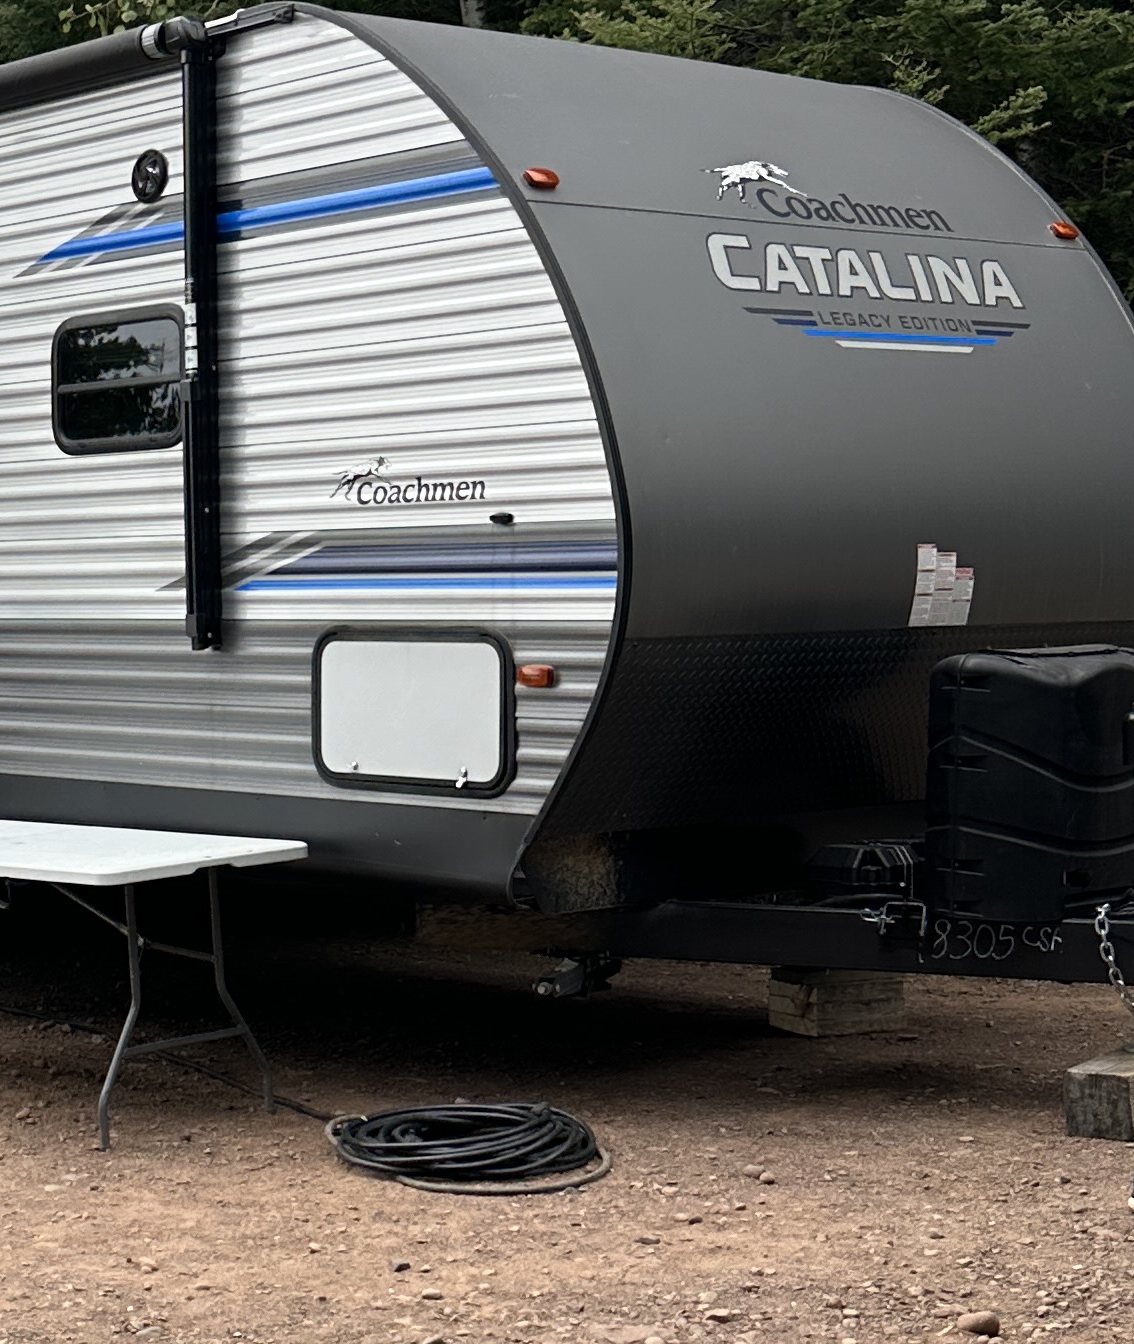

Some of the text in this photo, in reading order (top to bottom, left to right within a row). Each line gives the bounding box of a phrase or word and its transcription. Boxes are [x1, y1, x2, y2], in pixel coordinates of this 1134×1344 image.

[755, 187, 955, 233] Coachmen
[705, 231, 1026, 310] CATALINA
[817, 311, 973, 333] LEGACY EDITION
[356, 476, 486, 505] Coachmen
[931, 919, 1015, 960] 8305
